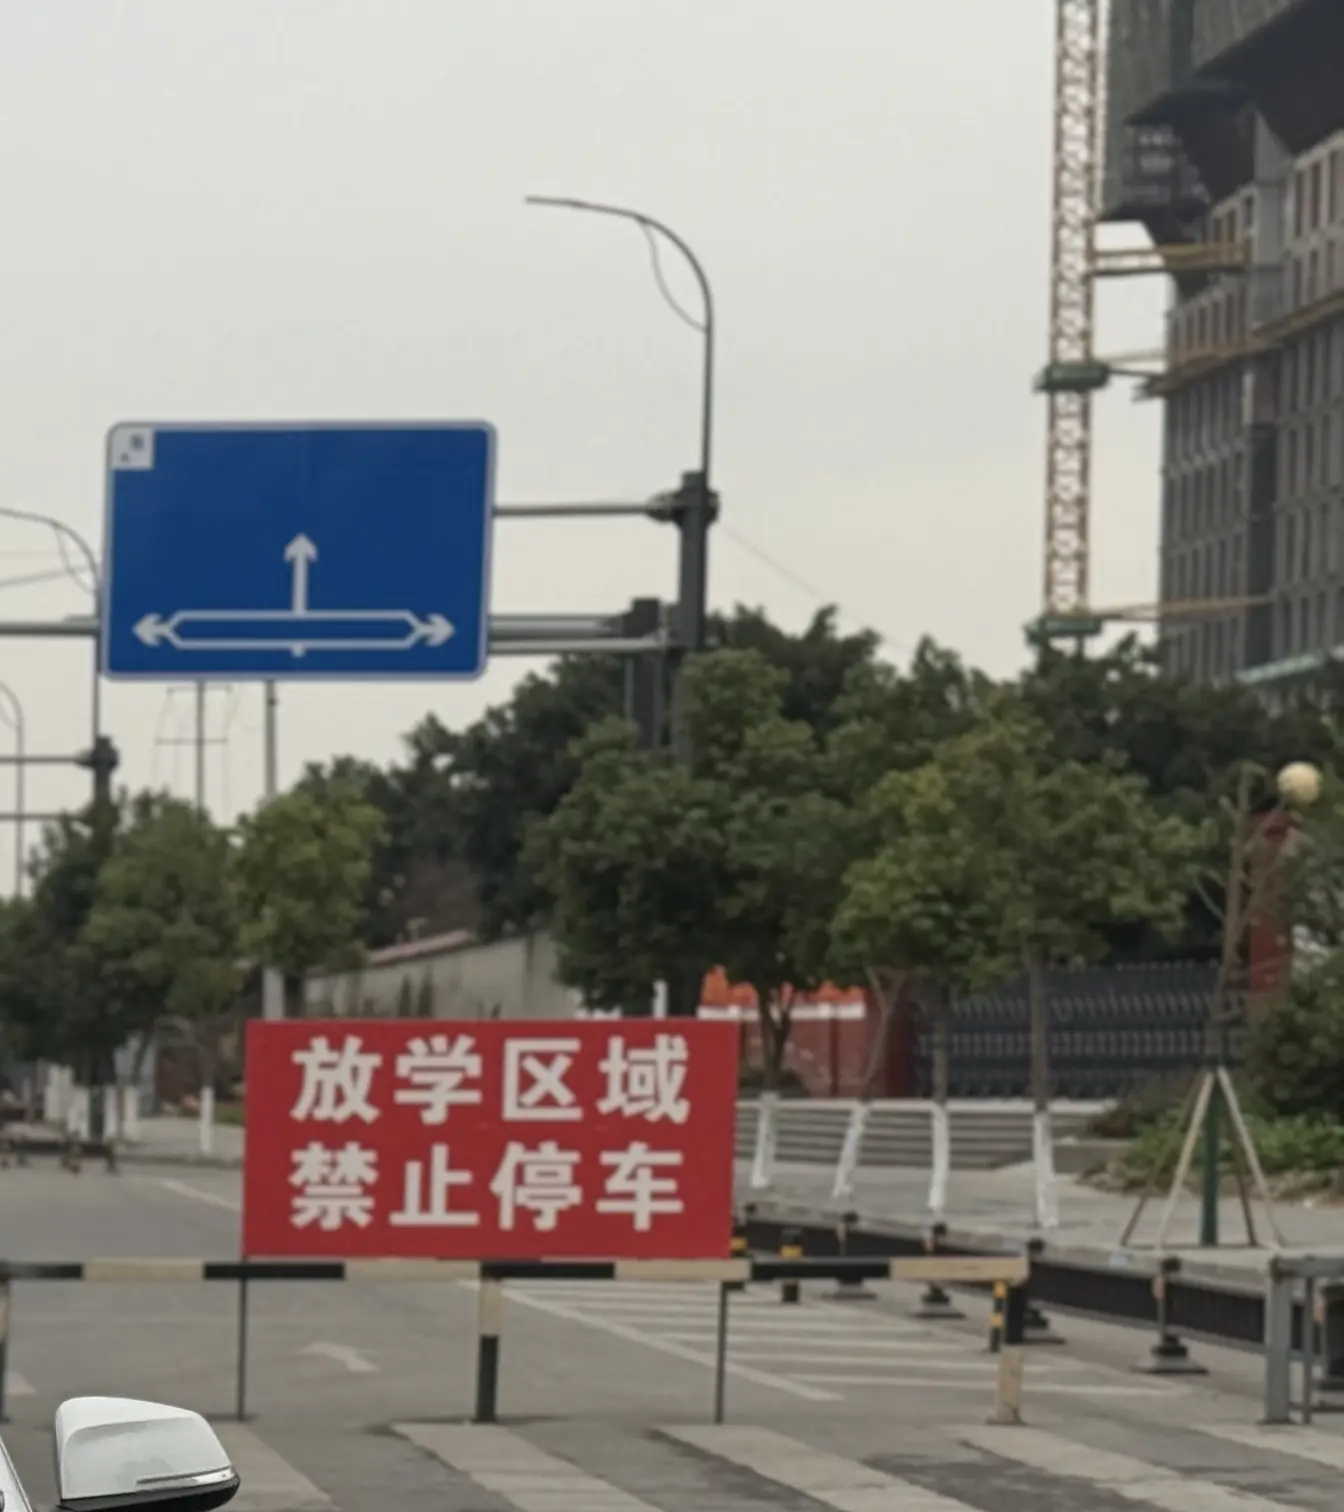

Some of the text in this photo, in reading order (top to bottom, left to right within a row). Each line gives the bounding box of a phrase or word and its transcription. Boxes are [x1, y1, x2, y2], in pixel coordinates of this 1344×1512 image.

[290, 1034, 691, 1125] 放学区域
[288, 1140, 685, 1232] 禁止停车
